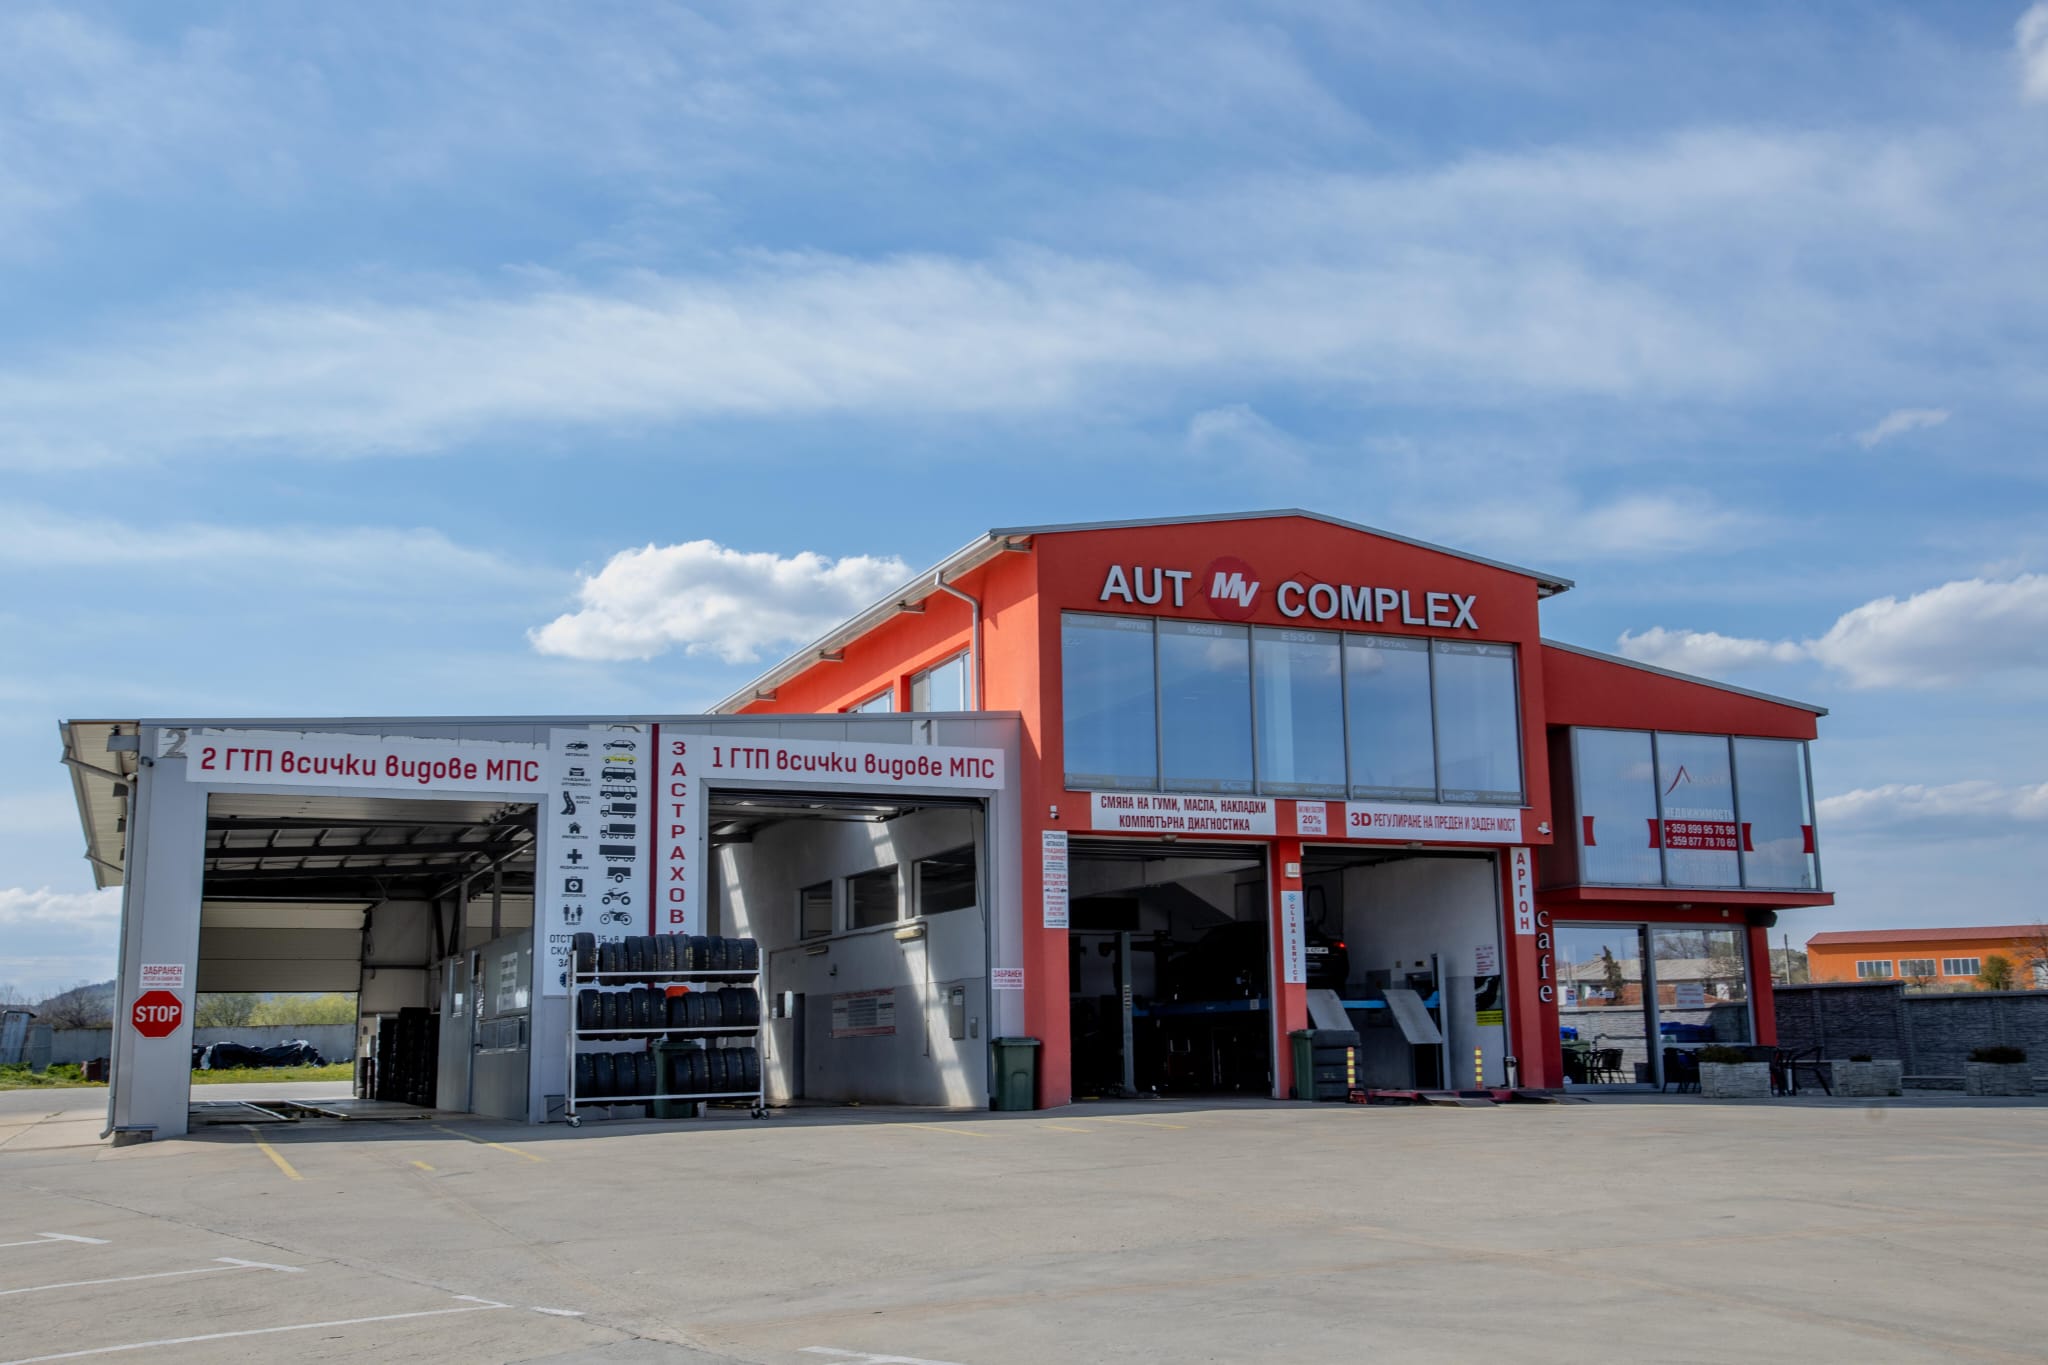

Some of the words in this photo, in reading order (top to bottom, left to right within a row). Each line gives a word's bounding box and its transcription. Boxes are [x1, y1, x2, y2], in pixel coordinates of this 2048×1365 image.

[1100, 565, 1192, 607] AUT
[1210, 572, 1260, 607] MV
[1276, 580, 1479, 630] COMPLEX
[163, 728, 188, 758] 2
[201, 747, 217, 770] 2
[226, 748, 272, 772] ГТП
[281, 751, 376, 776] всички
[385, 755, 477, 785] видове
[486, 758, 539, 782] МПС
[712, 747, 723, 768] 1
[730, 748, 769, 770] ГТП
[776, 750, 857, 773] всички
[864, 753, 943, 780] видове
[950, 757, 995, 779] МПС
[1101, 795, 1133, 809] СМЯНА
[1138, 797, 1149, 809] НА
[1152, 798, 1180, 812] ГУМИ,
[1184, 798, 1217, 813] МАСЛА,
[1221, 800, 1266, 814] НАКЛАДКИ
[1302, 815, 1321, 824] 20%
[1119, 815, 1184, 829] КОМПЮТЪРНА
[1188, 817, 1250, 831] ДИАГНОСТИКА
[1351, 812, 1372, 826] 3D
[1374, 813, 1422, 828] РЕГУЛИРАНЕ
[1424, 815, 1433, 829] НА
[1434, 815, 1463, 830] ПРЕДЕН
[1465, 817, 1470, 830] И
[1472, 817, 1495, 831] ЗАДЕН
[1497, 818, 1516, 832] МОСТ
[1703, 825, 1713, 834] 95
[669, 741, 687, 936] ЗАСТРАХОВ
[1516, 852, 1530, 930] АРГОН
[1289, 903, 1297, 934] CLIMA
[143, 966, 183, 975] ЗАБРАНЕН
[1537, 910, 1552, 1002] cafe
[135, 1005, 179, 1023] STOP
